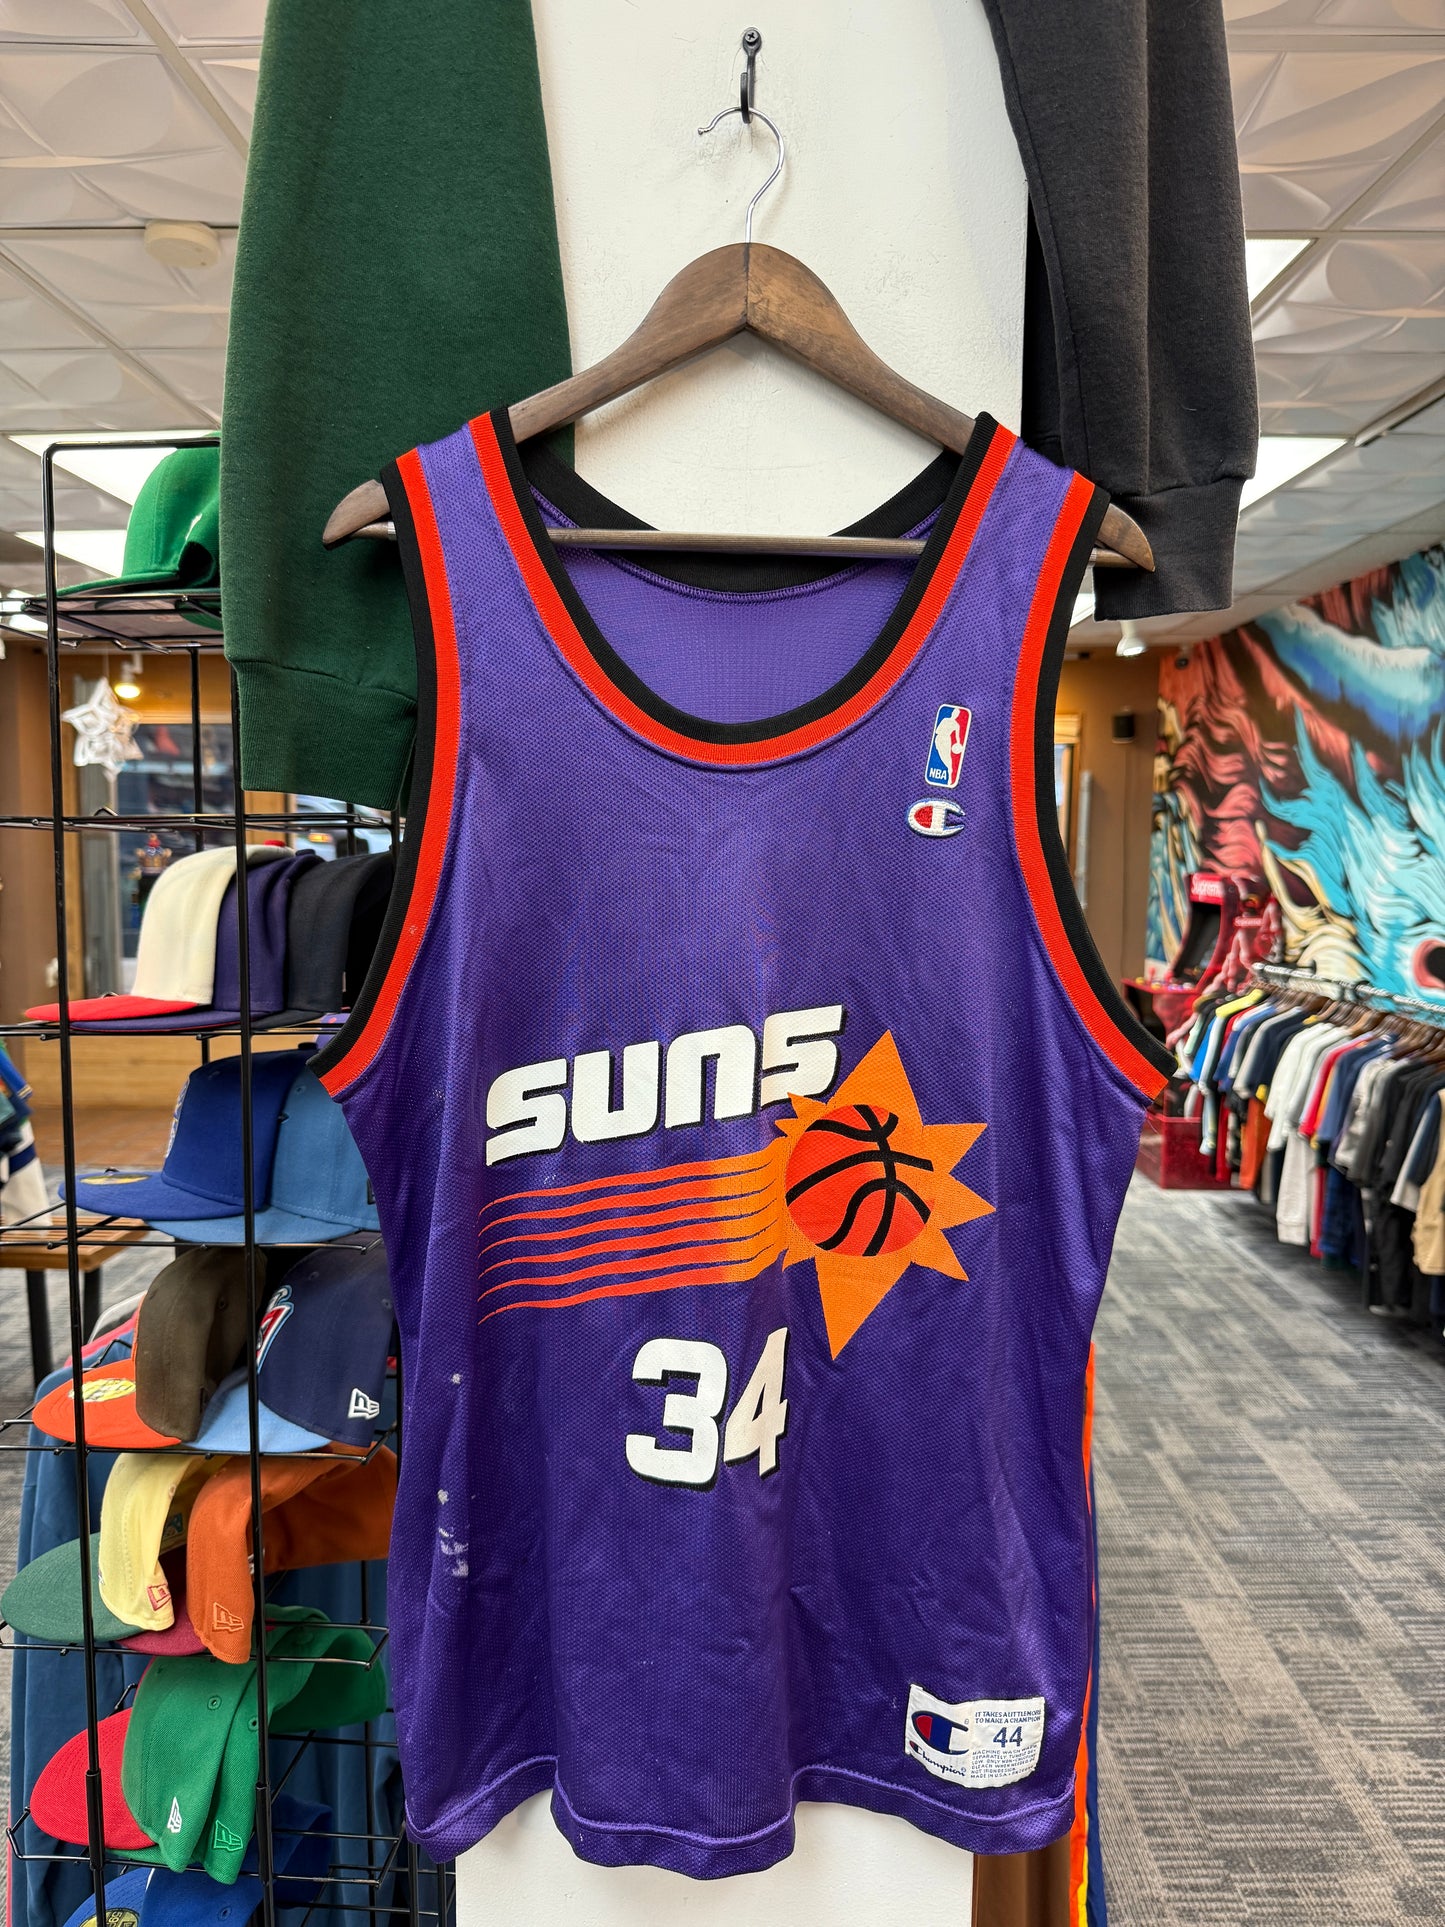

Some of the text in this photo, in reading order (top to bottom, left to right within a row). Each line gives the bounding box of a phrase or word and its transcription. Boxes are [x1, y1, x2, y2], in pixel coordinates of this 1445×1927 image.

[929, 767, 948, 781] NBA
[624, 1326, 790, 1492] 34
[1010, 1715, 1041, 1724] CHAMPION
[993, 1726, 1023, 1748] 44
[909, 1740, 966, 1777] Champion
